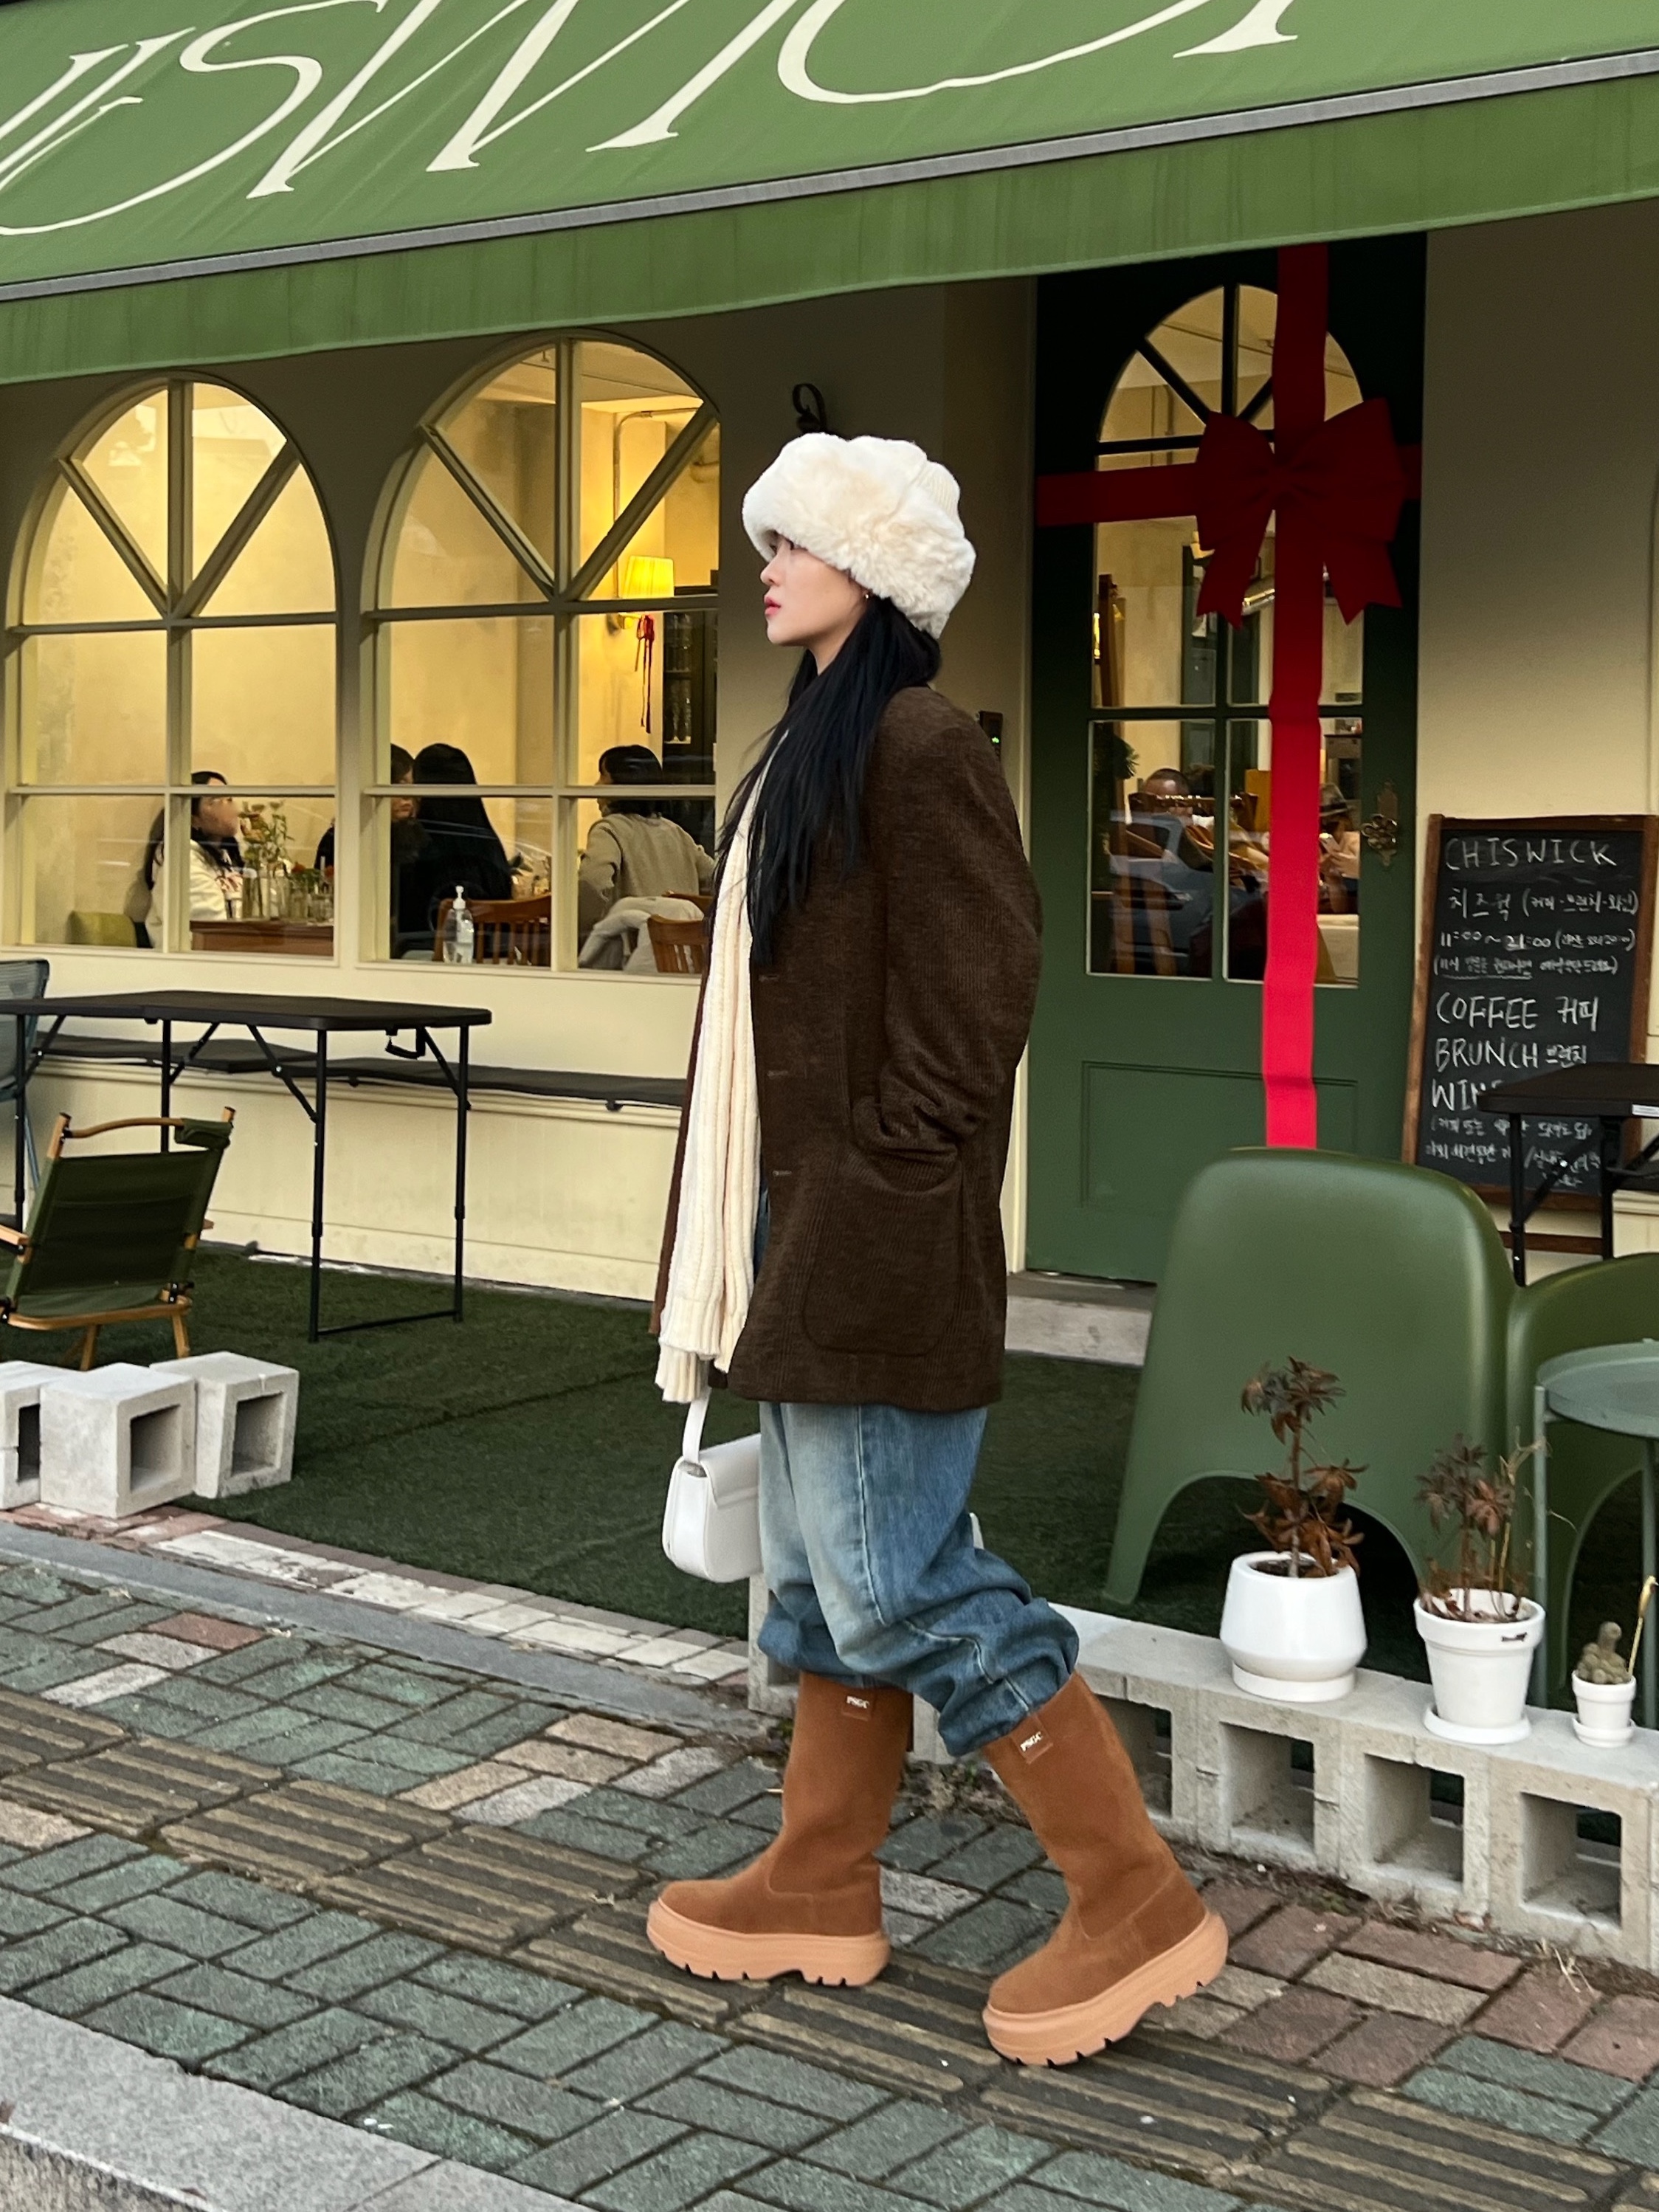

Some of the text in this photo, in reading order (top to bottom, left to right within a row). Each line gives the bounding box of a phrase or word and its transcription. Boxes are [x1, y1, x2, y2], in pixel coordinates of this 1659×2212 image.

[1444, 837, 1618, 870] CHISWICK
[1447, 886, 1511, 922] 치즈윅
[1436, 991, 1599, 1033] COFFEE 커피
[1435, 1036, 1587, 1073] BRUNCH 브런치
